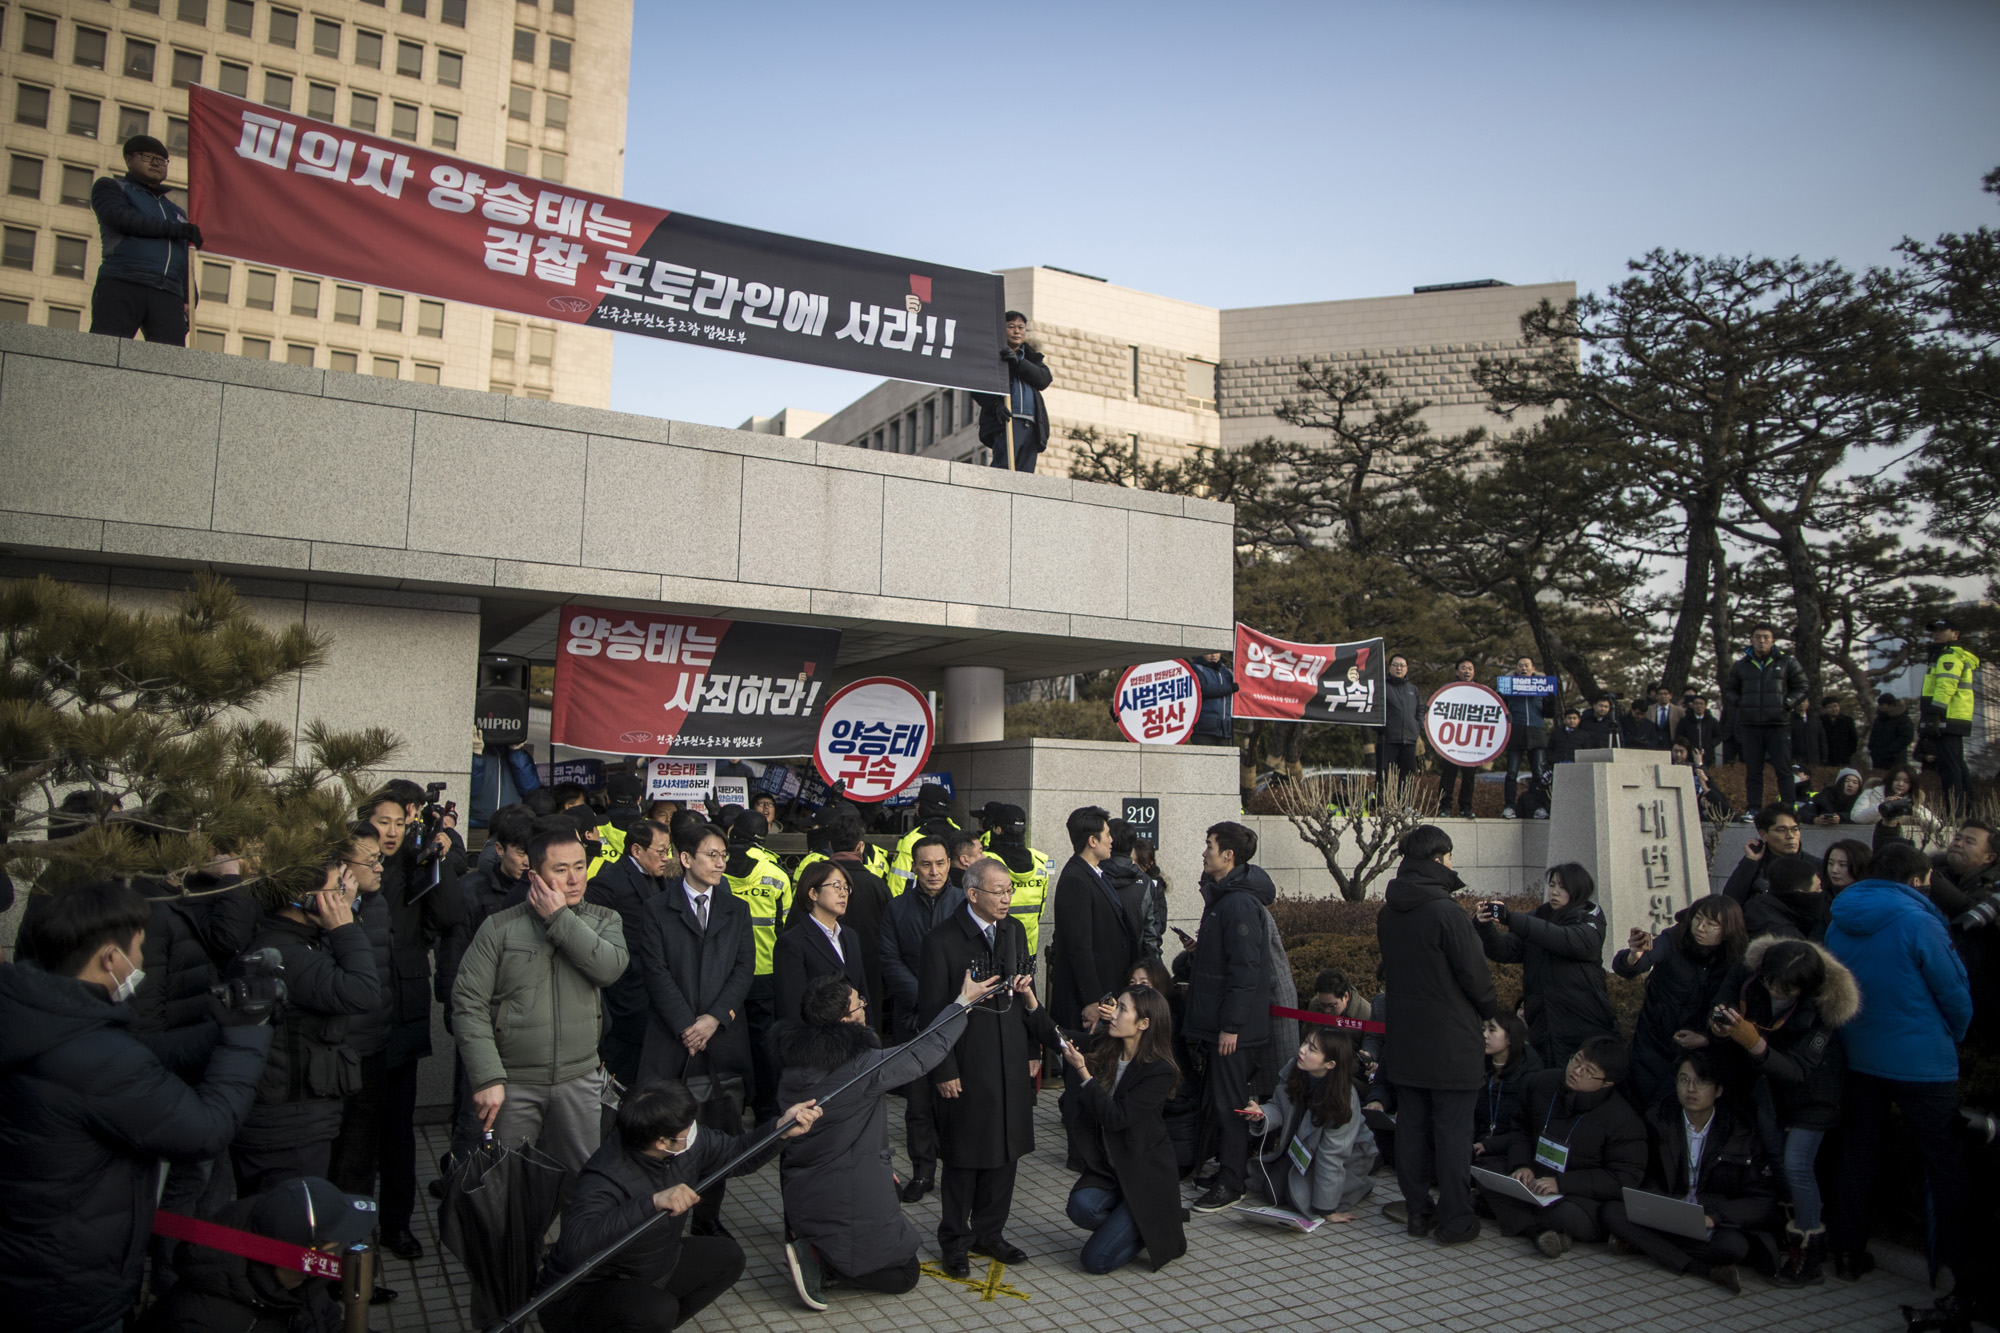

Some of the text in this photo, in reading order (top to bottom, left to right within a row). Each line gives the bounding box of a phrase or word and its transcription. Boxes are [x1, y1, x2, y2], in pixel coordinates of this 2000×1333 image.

[234, 110, 633, 249] 피의자 양승태는
[483, 226, 957, 360] 검찰 포토라인에 서라!!
[597, 305, 748, 345] 전국공무원노동조합 법원본부
[566, 615, 718, 667] 양승태는
[1130, 666, 1182, 687] 법원을 법원답게
[1244, 641, 1327, 687] 양승태
[663, 672, 822, 717] 사죄하라!
[1119, 674, 1193, 713] 사법적폐
[1322, 678, 1375, 713] 구속!
[1142, 701, 1186, 739] 청산
[1433, 701, 1502, 724] 적폐법관
[656, 734, 763, 748] 전국공무원노동조합 법원본부
[829, 719, 926, 758] 양승태
[1438, 721, 1496, 748] OUT!
[652, 779, 710, 789] 형사처벌하라!
[657, 763, 708, 776] 양승태를
[837, 754, 898, 790] 구속
[717, 785, 744, 794] 재판거래
[718, 795, 745, 803] 양승태와
[1126, 805, 1156, 824] 219
[1637, 799, 1674, 937] 대법원
